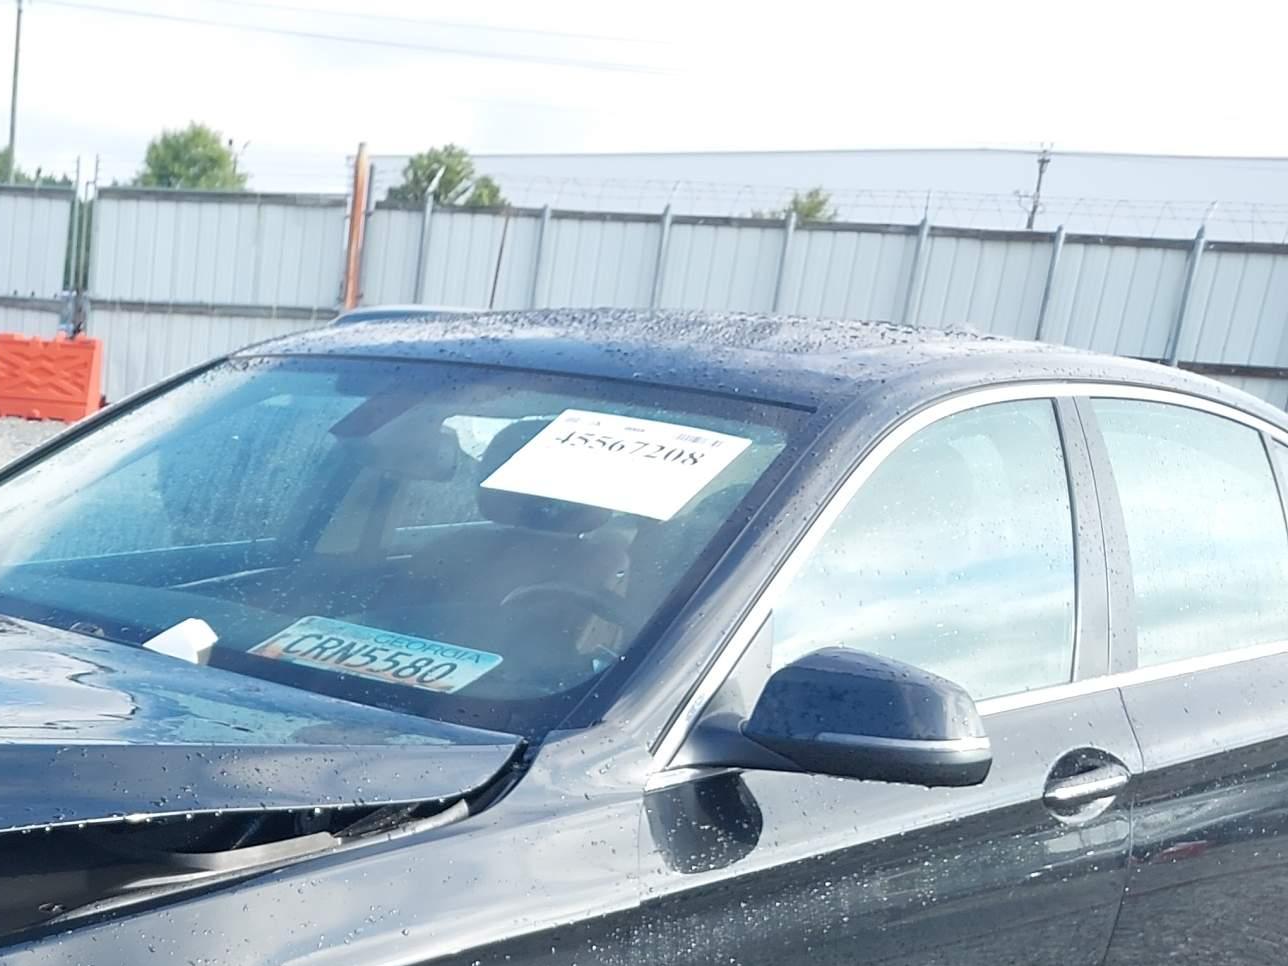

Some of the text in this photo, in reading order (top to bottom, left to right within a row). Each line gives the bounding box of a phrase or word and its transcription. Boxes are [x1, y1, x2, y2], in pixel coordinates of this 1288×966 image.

[554, 431, 705, 466] 45567208
[282, 633, 459, 684] CRN5580
[373, 633, 481, 664] GEORGIA
